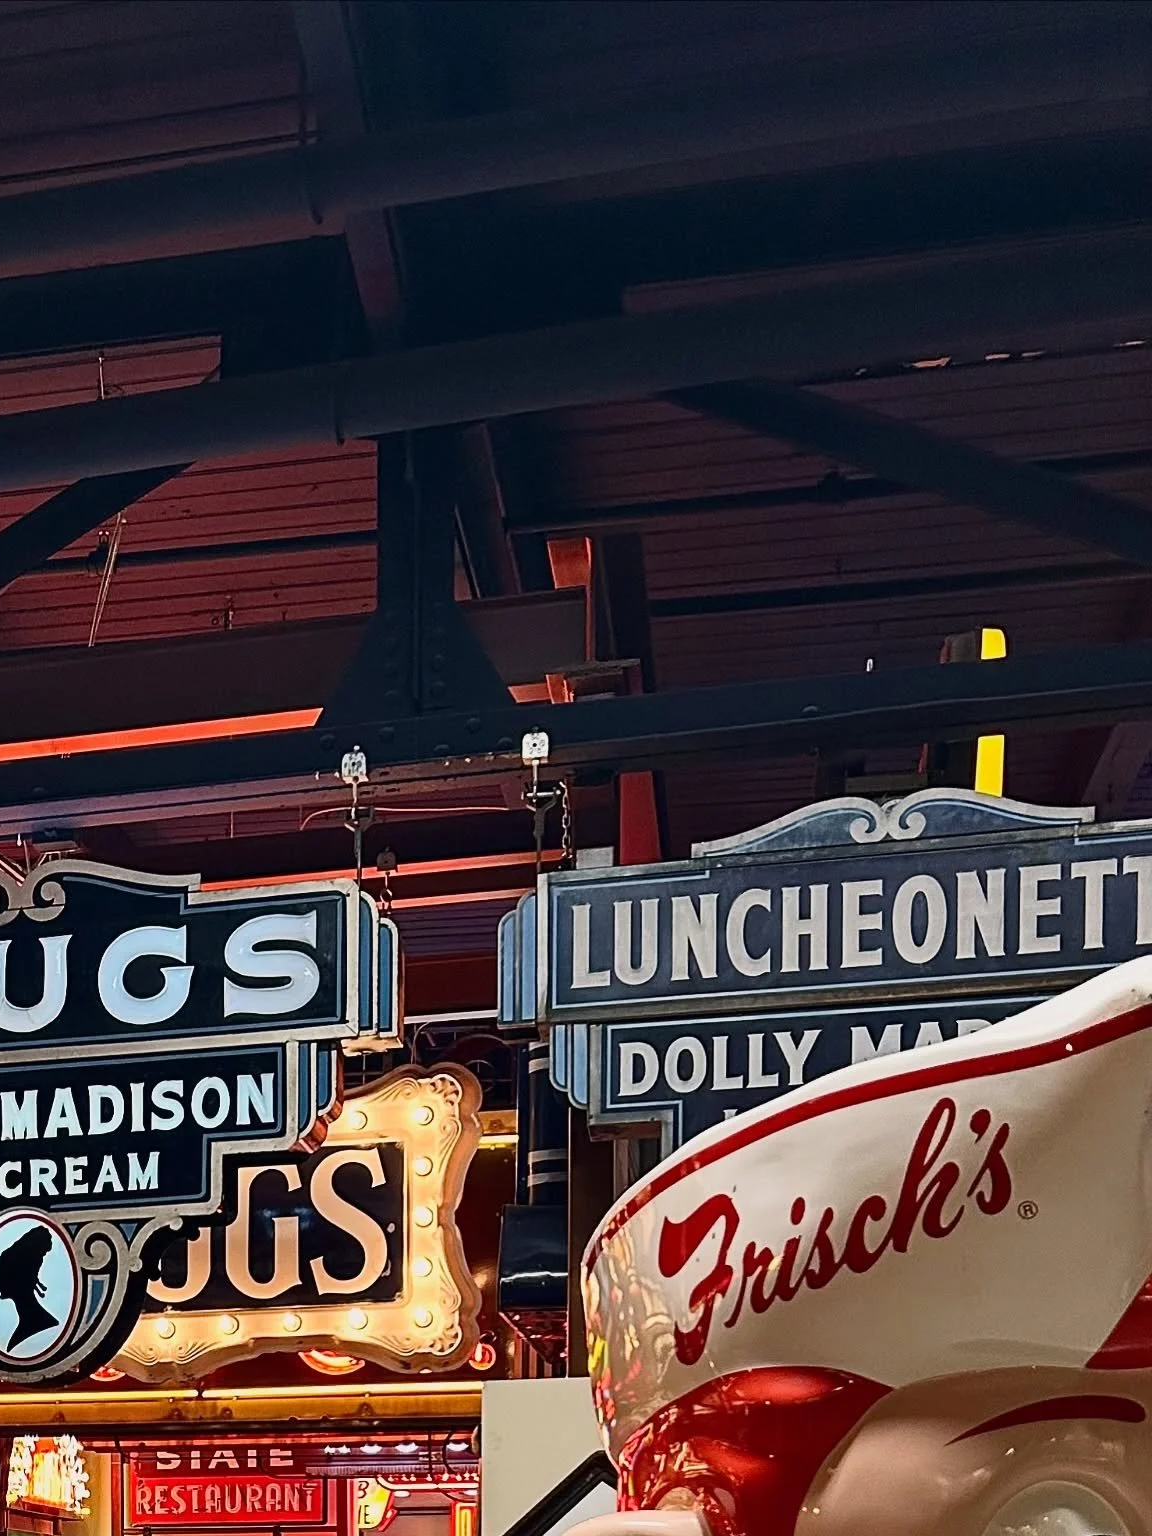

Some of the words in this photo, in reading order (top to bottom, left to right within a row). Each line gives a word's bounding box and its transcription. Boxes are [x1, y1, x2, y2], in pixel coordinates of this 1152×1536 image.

[617, 1029, 823, 1097] DOLLY
[658, 1097, 1012, 1365] Frisch's
[135, 1482, 318, 1516] RESTAURANT
